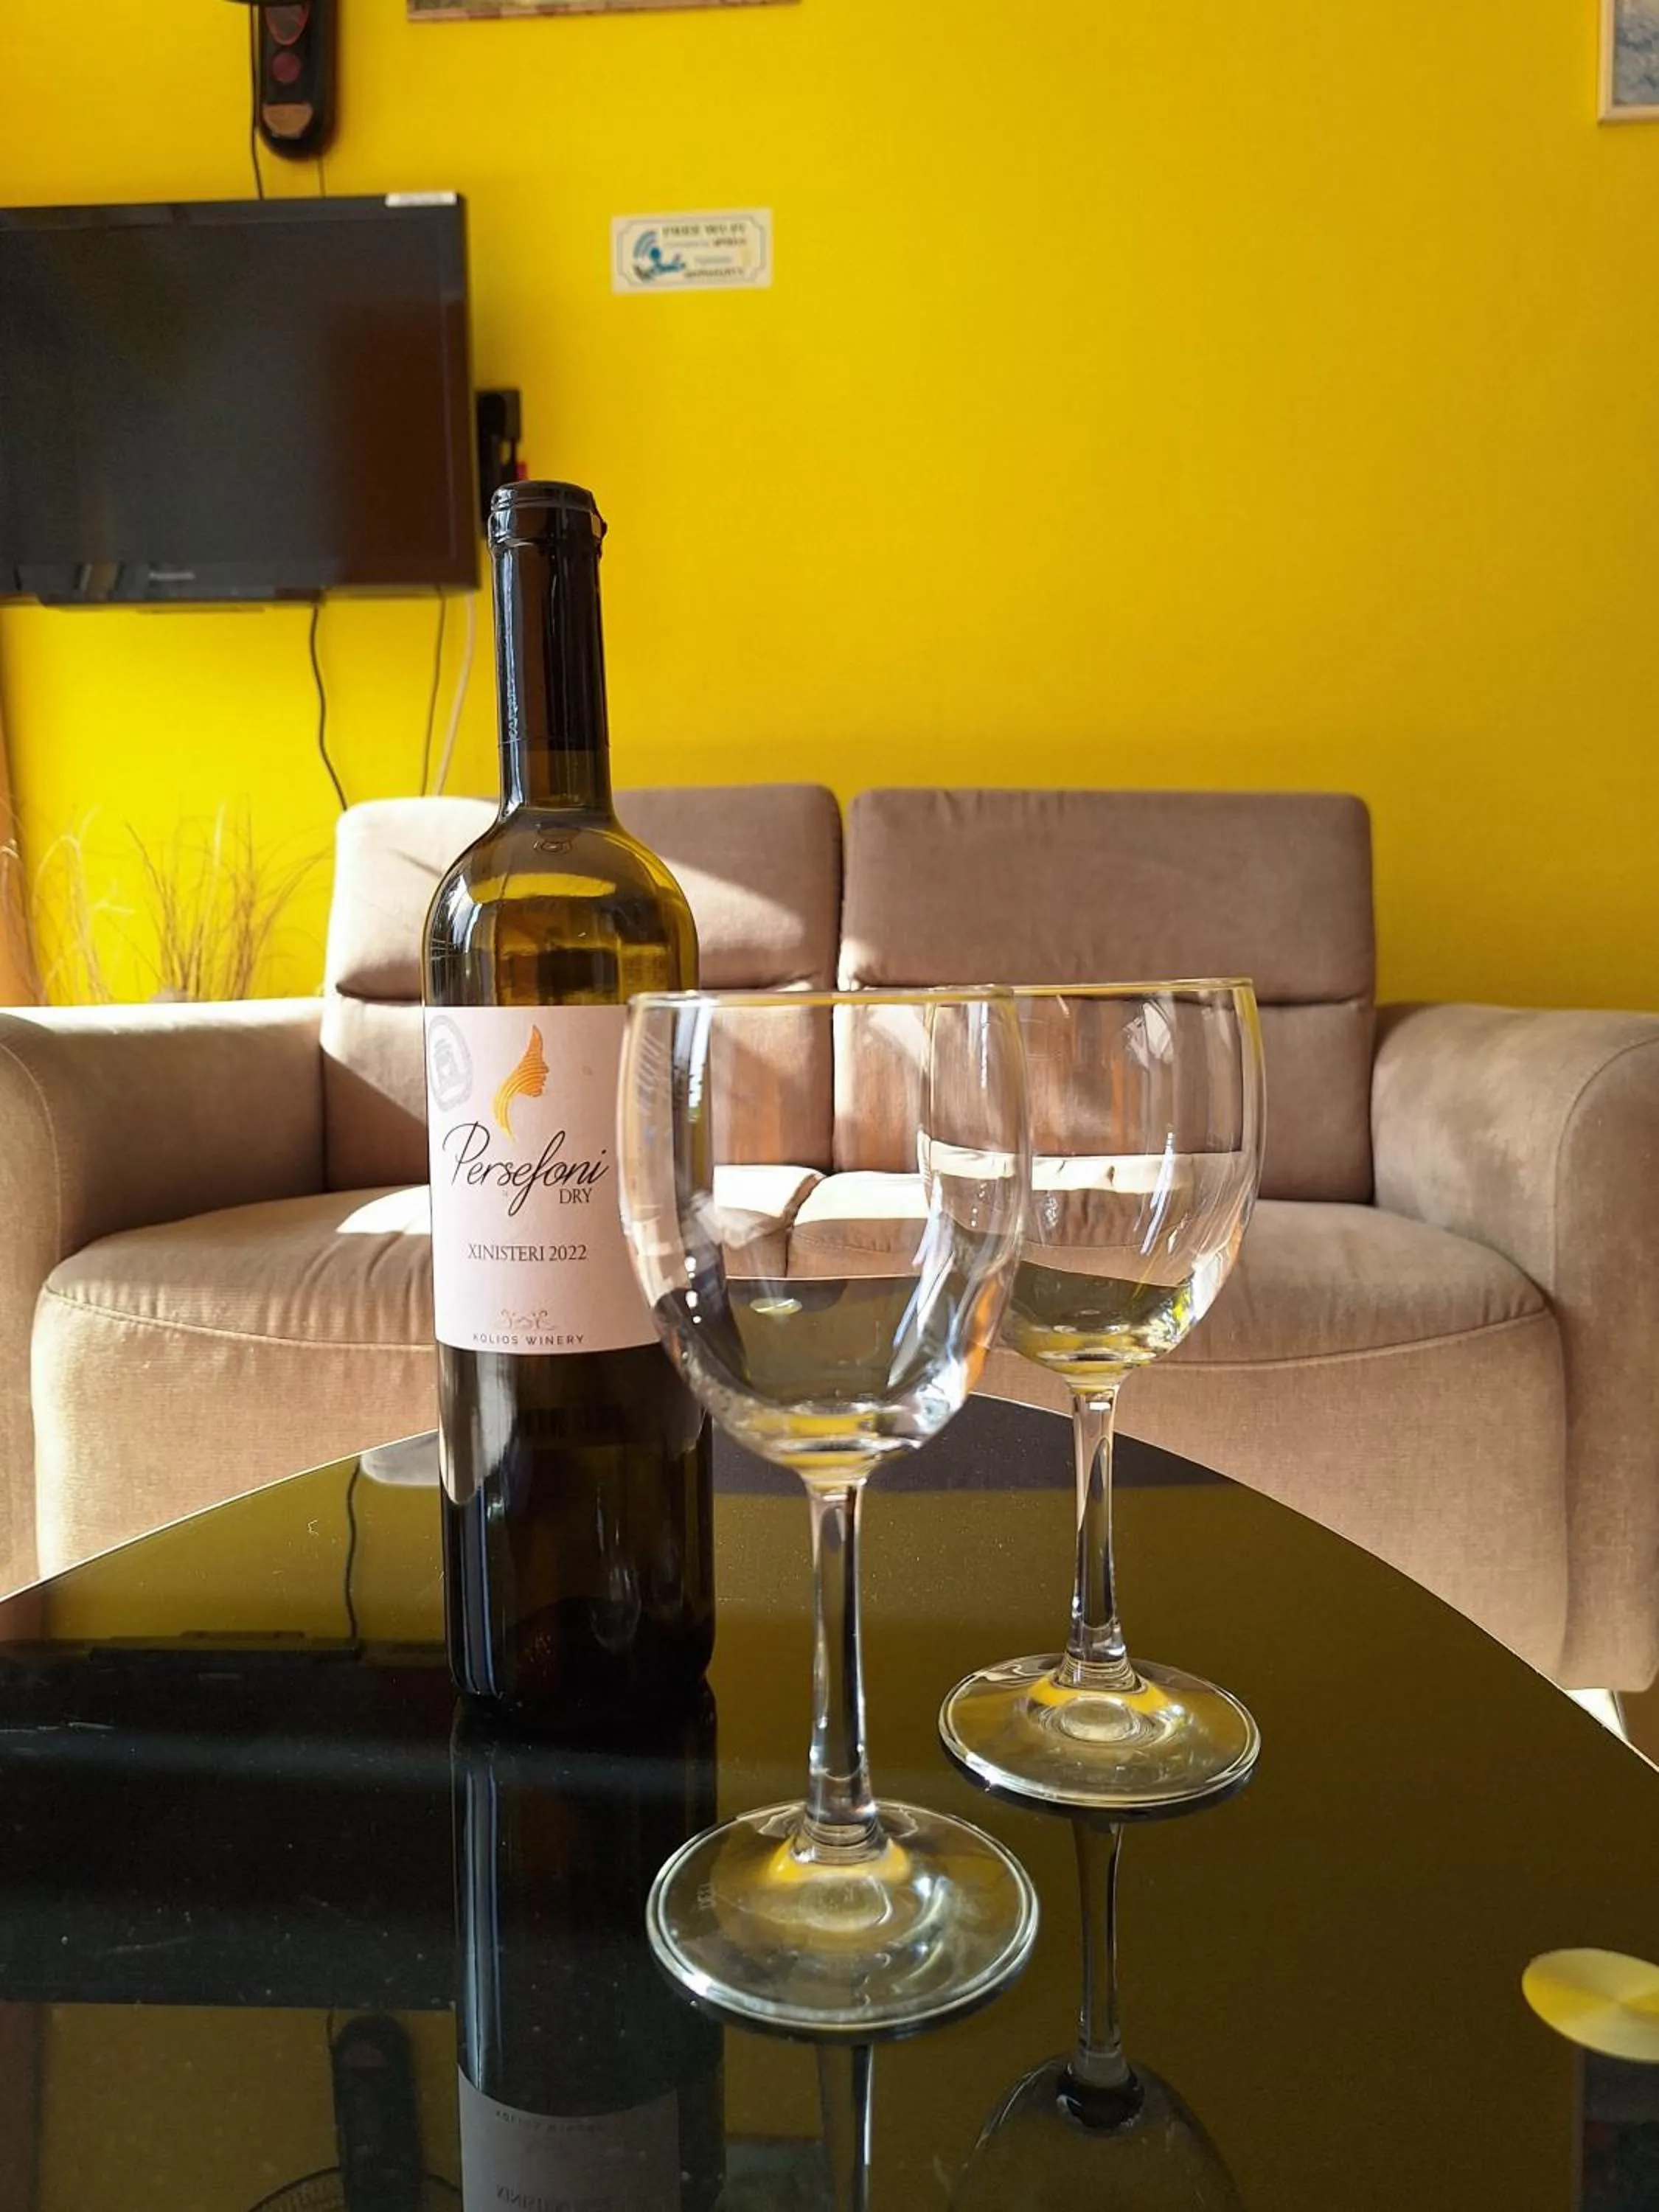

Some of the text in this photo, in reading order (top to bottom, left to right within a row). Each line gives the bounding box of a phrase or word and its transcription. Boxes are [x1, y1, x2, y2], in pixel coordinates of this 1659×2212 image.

[442, 1121, 609, 1217] Persefoni
[559, 1188, 591, 1204] DRY
[467, 1243, 587, 1262] XINISTERI 2022
[473, 1332, 585, 1346] KOLIOS WINERY
